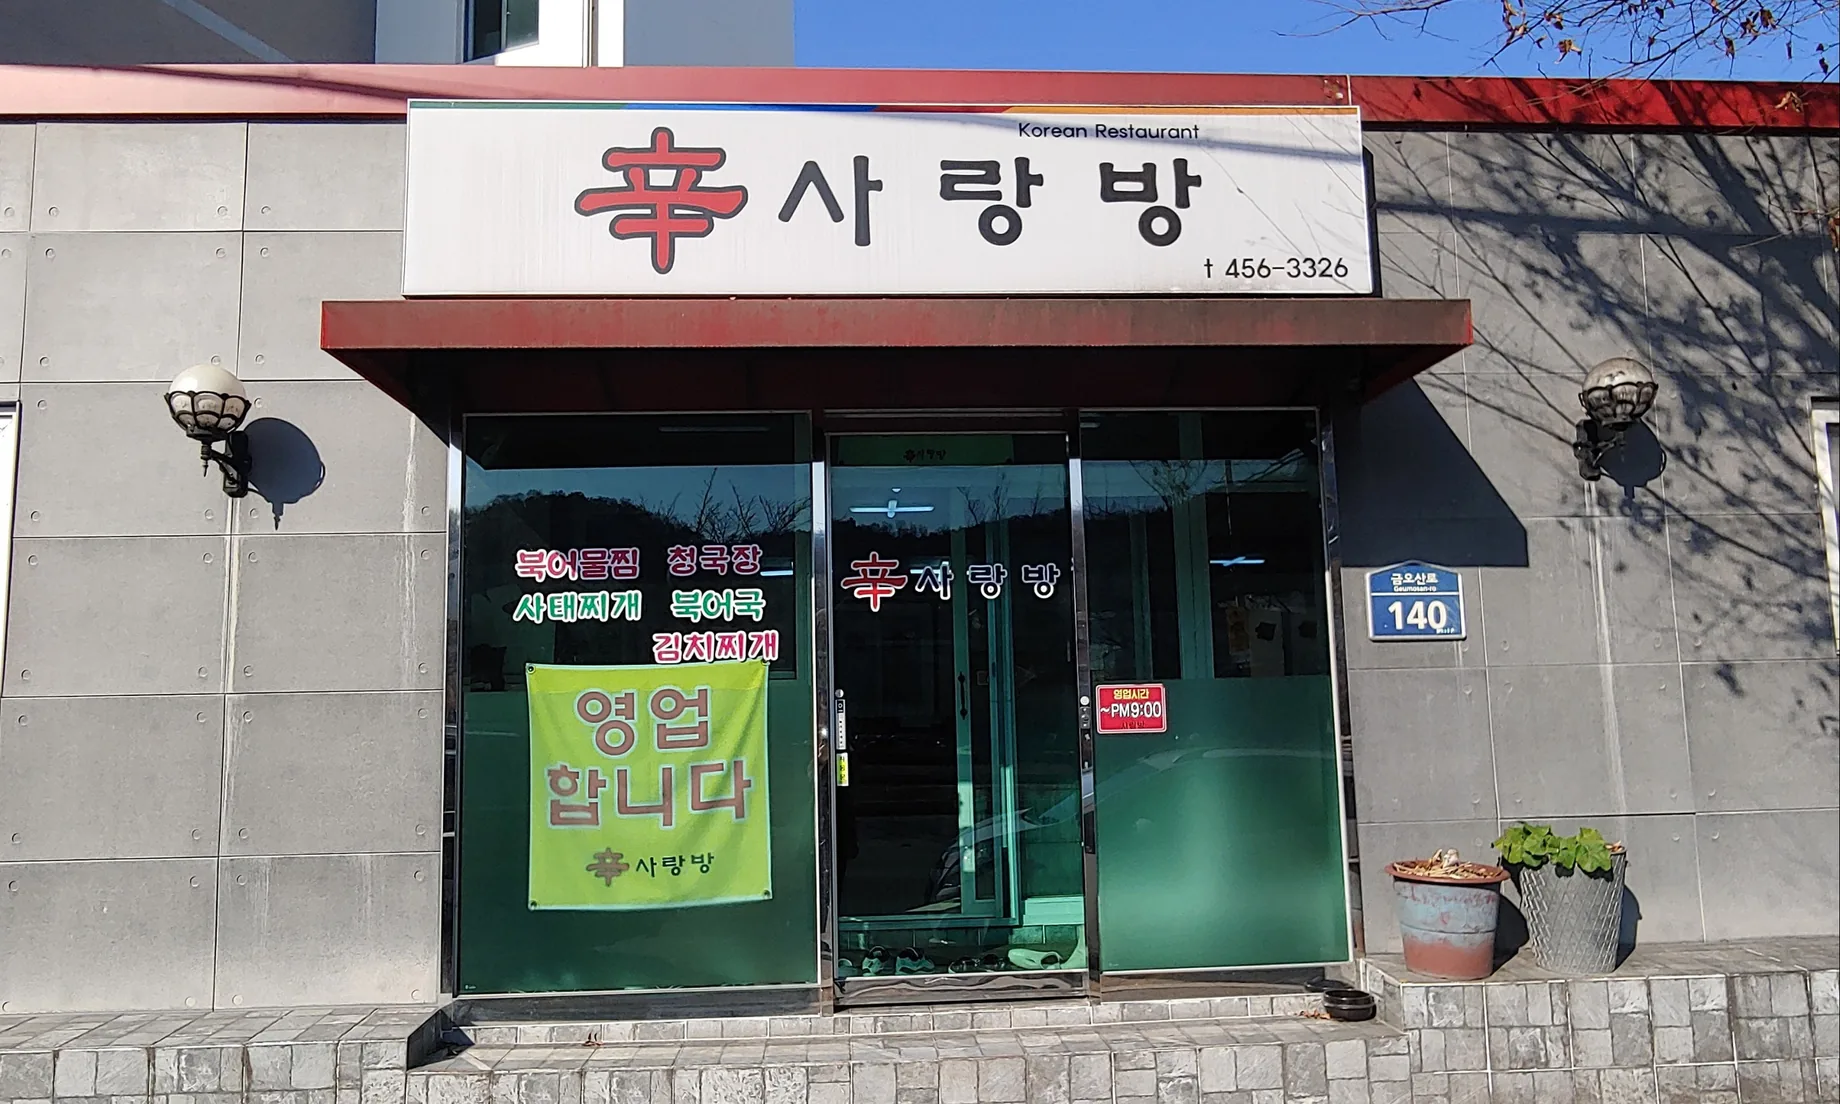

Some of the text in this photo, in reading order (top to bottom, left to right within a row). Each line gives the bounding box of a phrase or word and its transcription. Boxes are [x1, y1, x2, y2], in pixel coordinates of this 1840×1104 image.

[1018, 122, 1200, 141] Korean Restaurant
[1203, 257, 1349, 280] t 456-3326
[514, 544, 763, 583] 북어물찜 청국장
[1390, 572, 1440, 586] 금오산로
[512, 588, 767, 624] 사태찌개 북어국
[1387, 600, 1448, 630] 140
[652, 629, 780, 664] 김치찌개
[1113, 688, 1150, 700] 영업시간
[575, 686, 711, 757] 영업
[546, 759, 753, 828] 합니다
